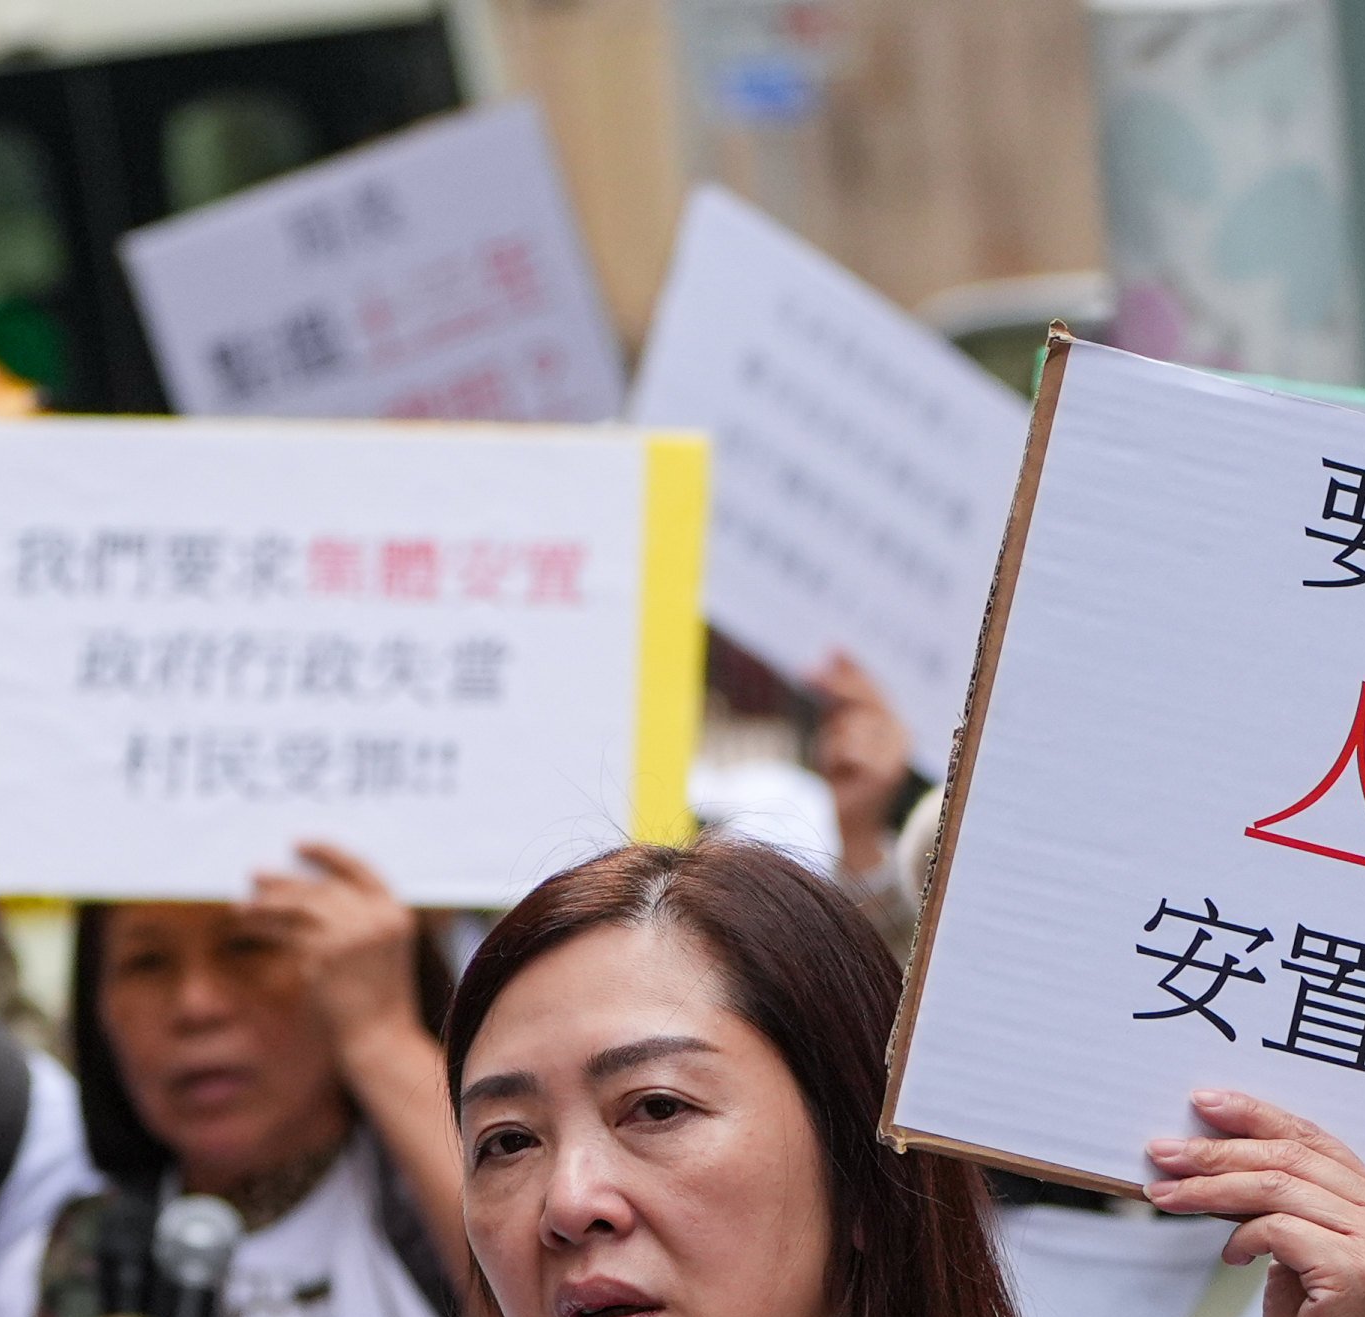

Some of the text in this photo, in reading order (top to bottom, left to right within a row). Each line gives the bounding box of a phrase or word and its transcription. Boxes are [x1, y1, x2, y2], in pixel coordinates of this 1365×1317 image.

[11, 530, 587, 605] 我們要求集體安置
[75, 626, 511, 706] 政府行政失當
